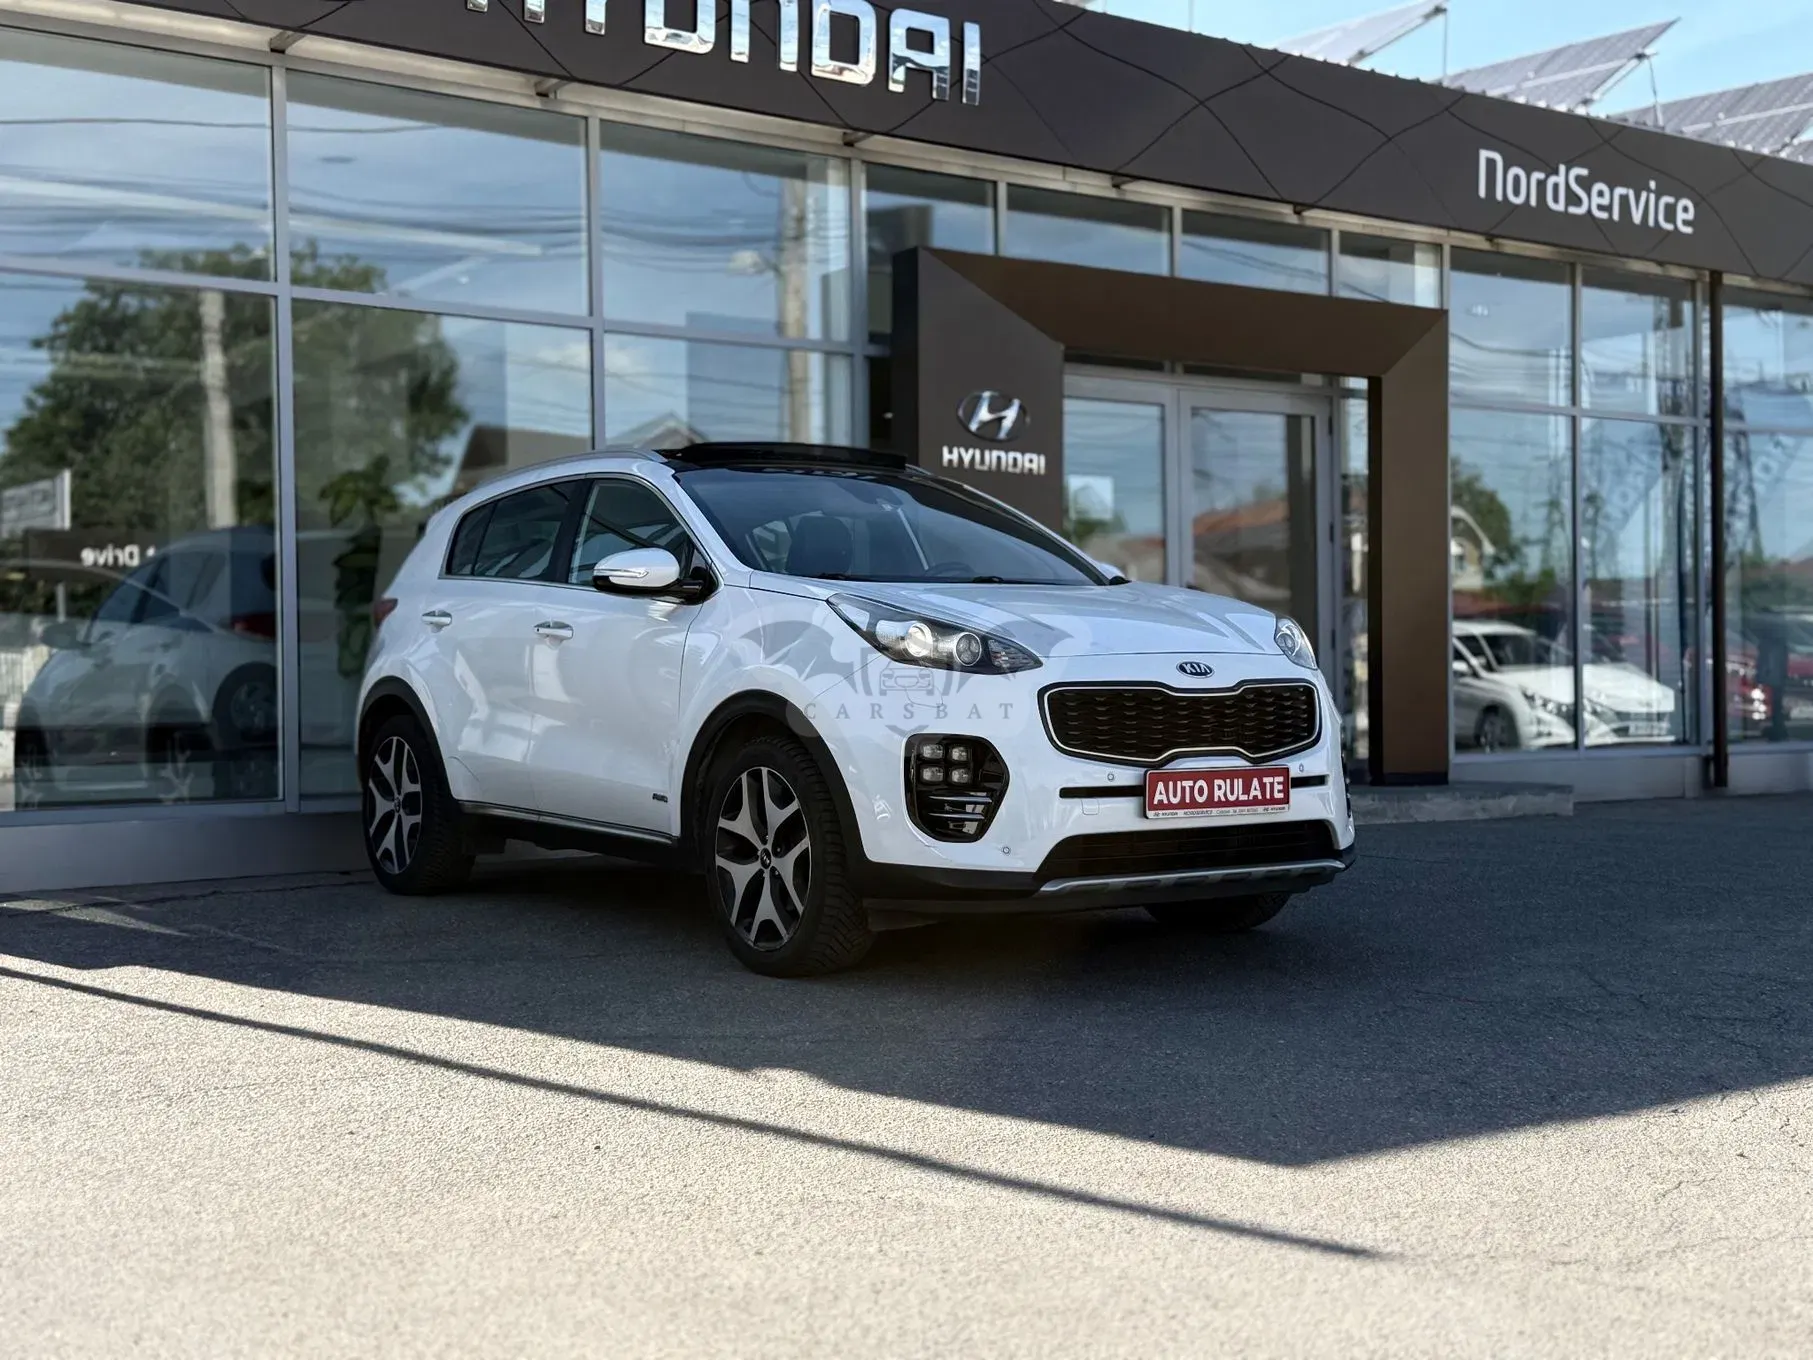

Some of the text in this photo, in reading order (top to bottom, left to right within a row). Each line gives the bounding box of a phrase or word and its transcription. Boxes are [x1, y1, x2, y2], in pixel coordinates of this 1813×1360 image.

[465, 0, 982, 106] UNDAI
[1478, 148, 1695, 234] NordService
[942, 445, 1046, 475] HYUNDAI
[1182, 663, 1210, 673] KIA
[1153, 776, 1284, 804] AUTO RULATE
